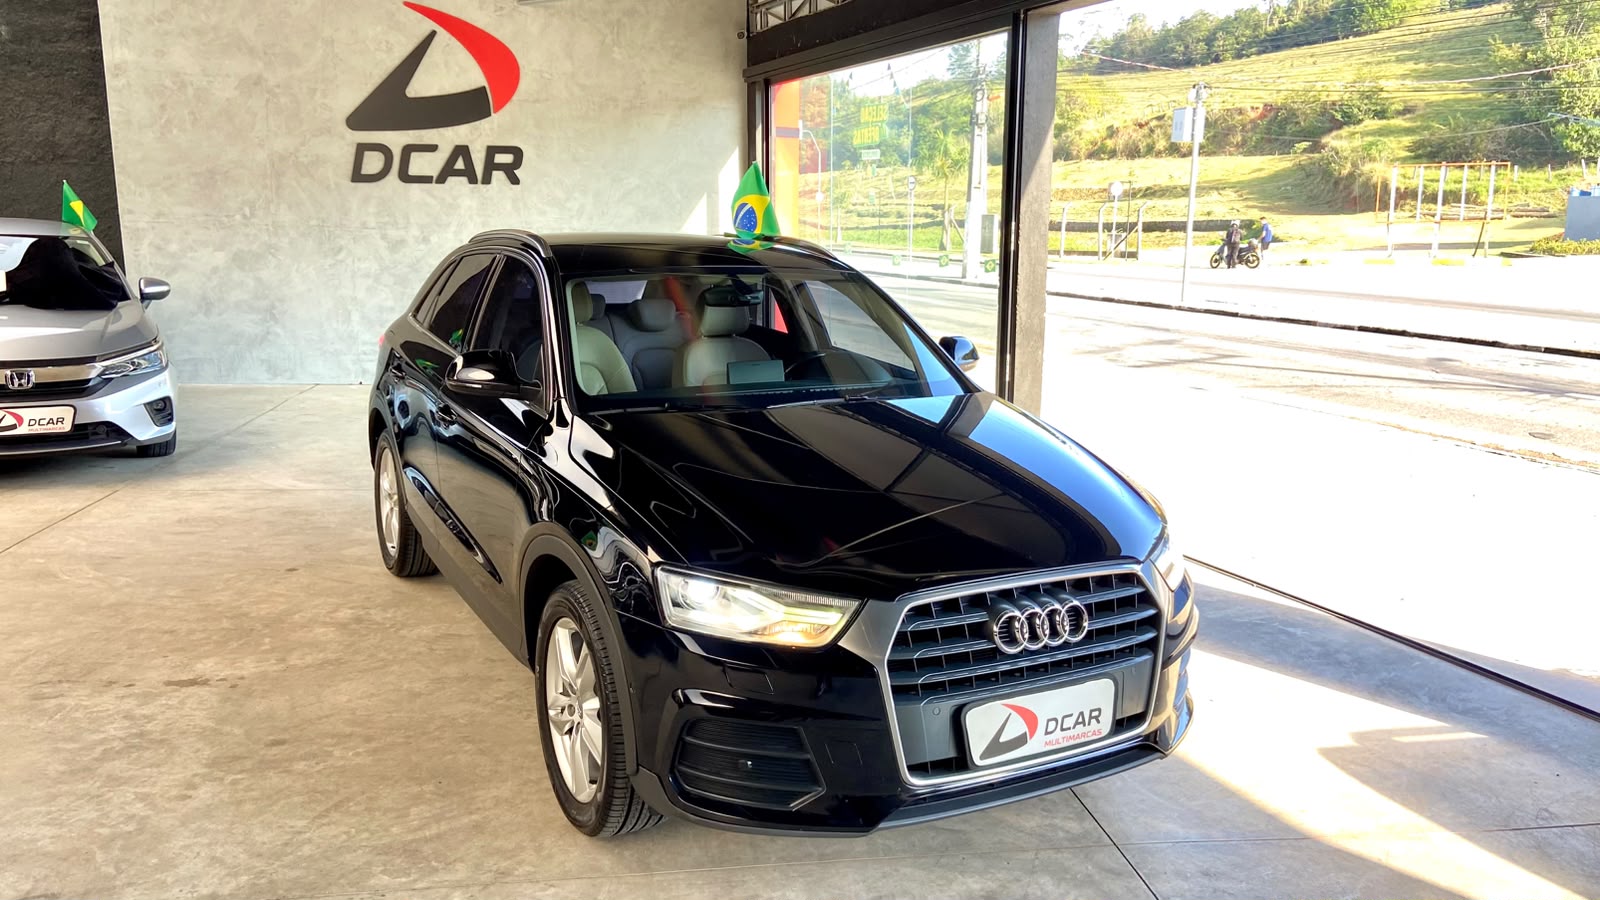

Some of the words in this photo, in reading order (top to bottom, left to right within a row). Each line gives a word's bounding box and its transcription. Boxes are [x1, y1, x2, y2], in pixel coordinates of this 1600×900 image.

[350, 142, 523, 185] DCAR
[28, 417, 65, 427] DCAR
[1044, 708, 1101, 735] DCAR
[1044, 729, 1102, 747] MULTIMARCAS
